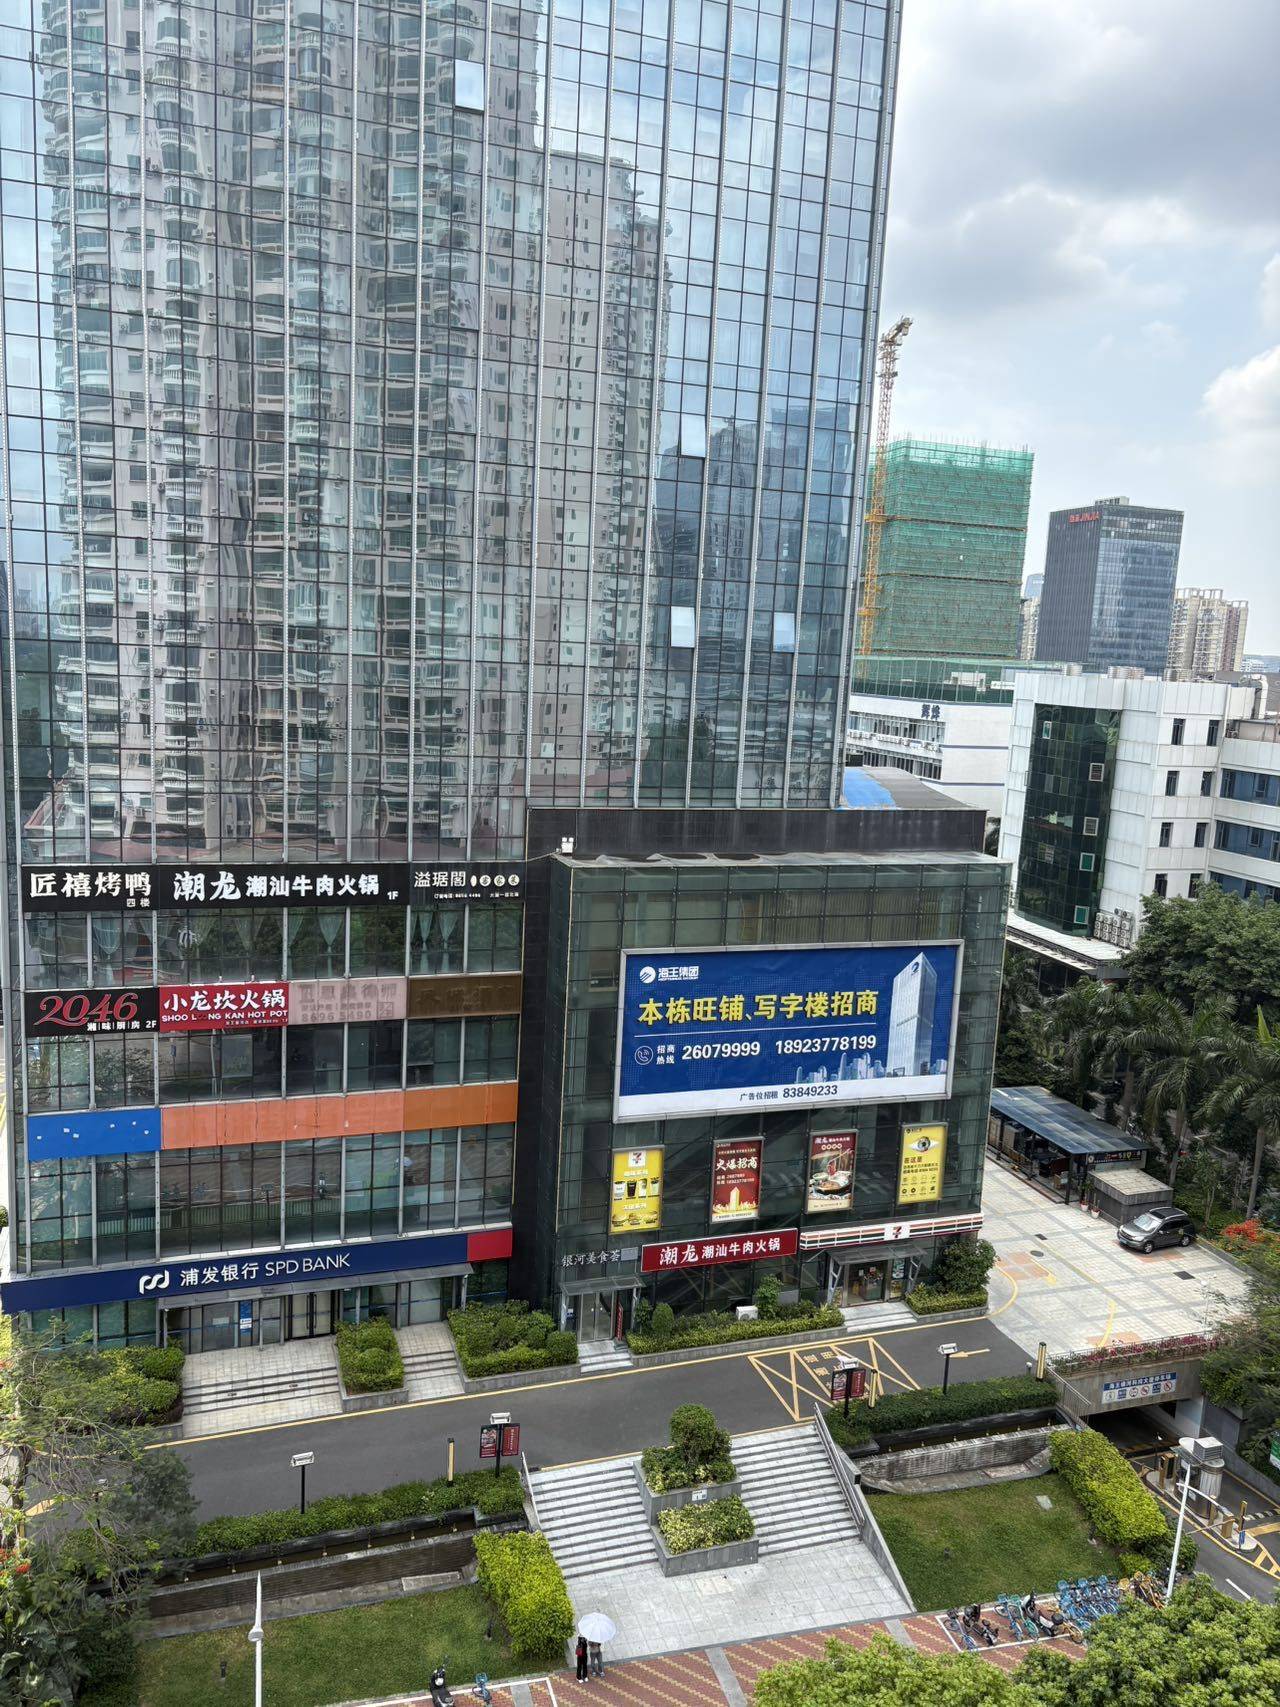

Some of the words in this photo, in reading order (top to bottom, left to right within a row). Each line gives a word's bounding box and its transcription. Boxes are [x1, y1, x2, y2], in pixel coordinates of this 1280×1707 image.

[30, 872, 152, 898] 匠禧烤鸭
[173, 871, 242, 901] 潮龙
[246, 874, 379, 897] 潮汕牛肉火锅
[387, 891, 399, 900] 1F
[126, 898, 150, 908] 四楼
[658, 965, 699, 978] 海王集团
[33, 992, 139, 1027] 2046
[164, 989, 286, 1012] 小龙坎火锅
[638, 989, 878, 1026] 本栋旺铺、写字楼招商
[145, 1020, 157, 1029] 2F
[161, 1014, 189, 1022] SHOO
[225, 1011, 244, 1020] KAN
[247, 1010, 266, 1018] HOT
[270, 1009, 287, 1017] POT
[656, 1045, 676, 1055] 招商
[682, 1041, 760, 1060] 26079999
[776, 1035, 876, 1055] 18923778199
[656, 1055, 675, 1065] 热线
[783, 1084, 838, 1099] 83849233
[659, 1244, 699, 1265] 潮龙
[701, 1237, 780, 1259] 潮汕牛肉火锅
[180, 1262, 259, 1287] 浦发银行
[265, 1260, 299, 1277] SPD
[302, 1252, 350, 1273] BANK
